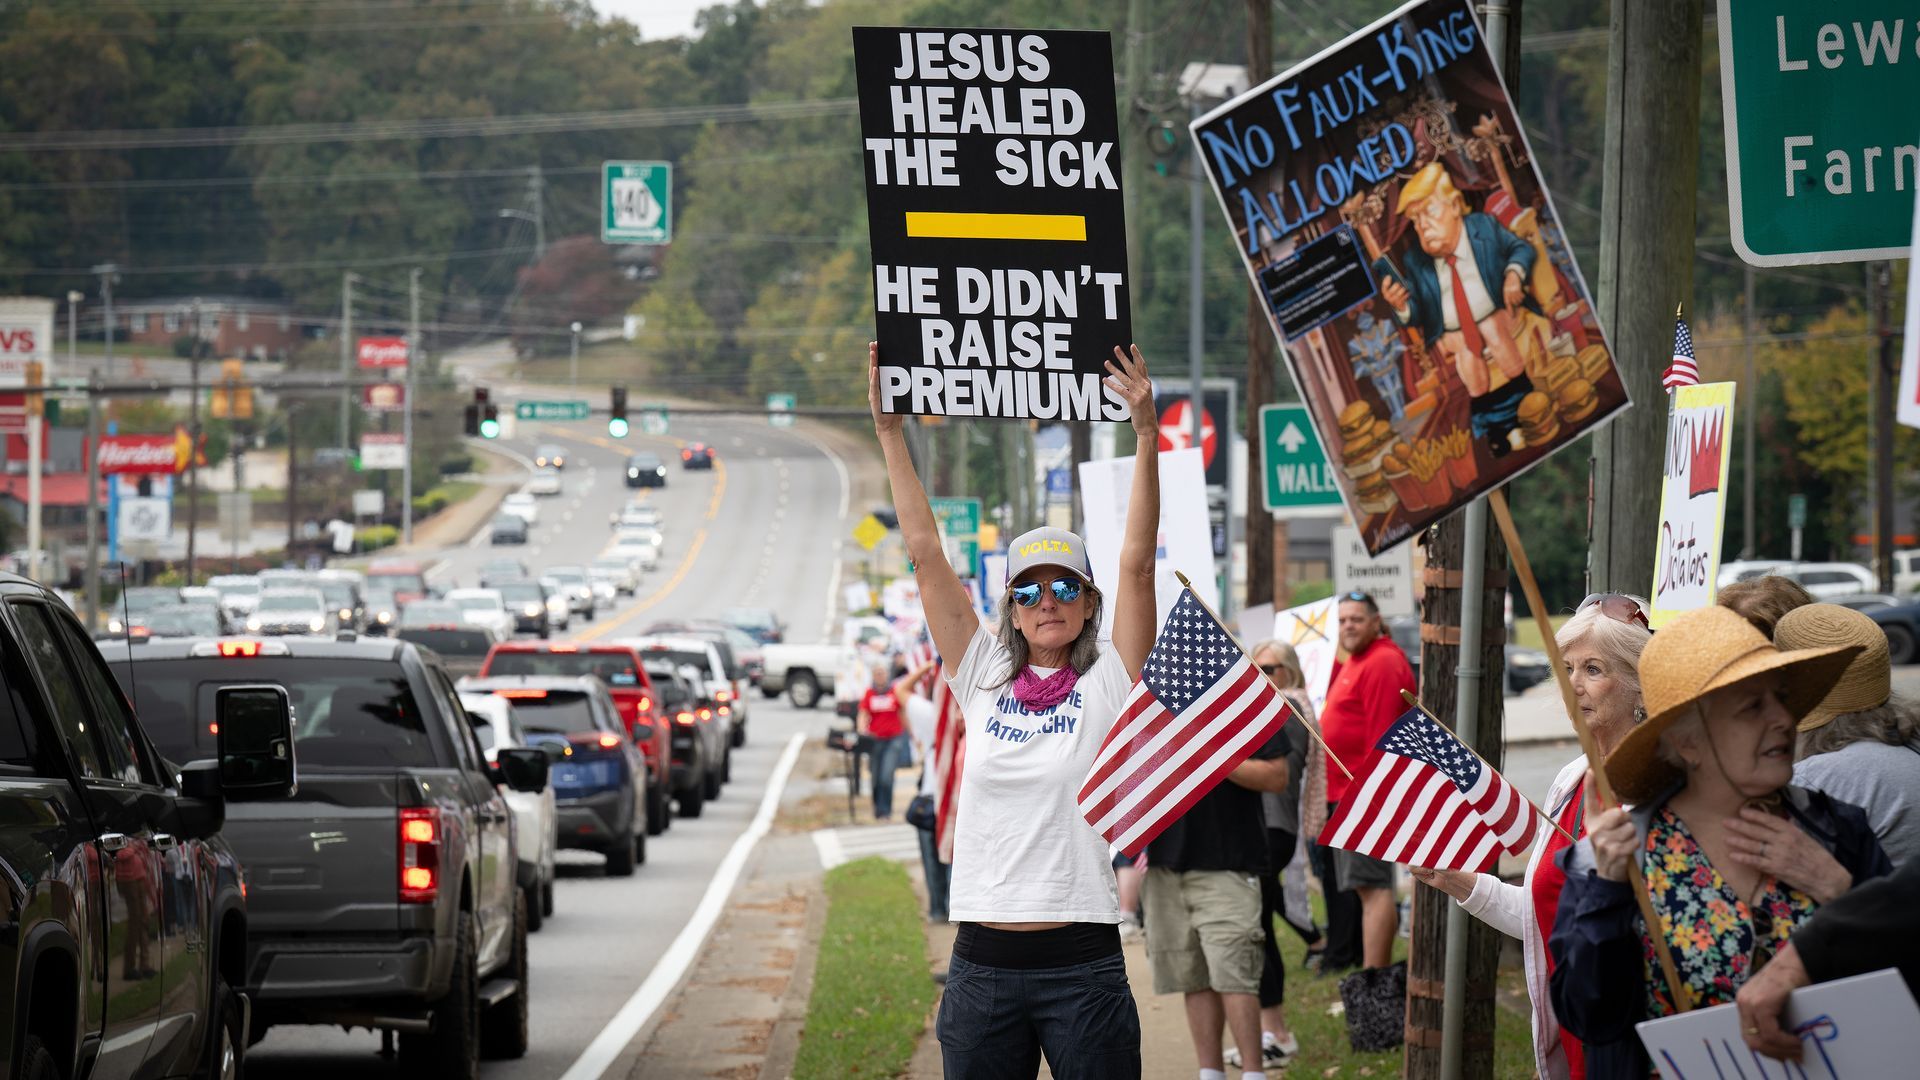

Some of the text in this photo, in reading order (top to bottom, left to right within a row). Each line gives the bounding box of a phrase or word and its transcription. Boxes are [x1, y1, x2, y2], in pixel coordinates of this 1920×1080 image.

[894, 32, 1050, 82] JESUS
[1776, 15, 1920, 71] Lew
[890, 85, 1086, 135] HEALED
[865, 138, 1119, 190] THE SICK
[1238, 122, 1415, 254] ALLOWED
[615, 188, 650, 219] 140
[876, 265, 1123, 320] HE DIDN'T
[921, 318, 1073, 370] RAISE
[879, 366, 1132, 422] PREMIUMS
[1276, 462, 1337, 494] WALE
[1019, 539, 1073, 558] VOLTA
[1347, 564, 1401, 579] Downtown
